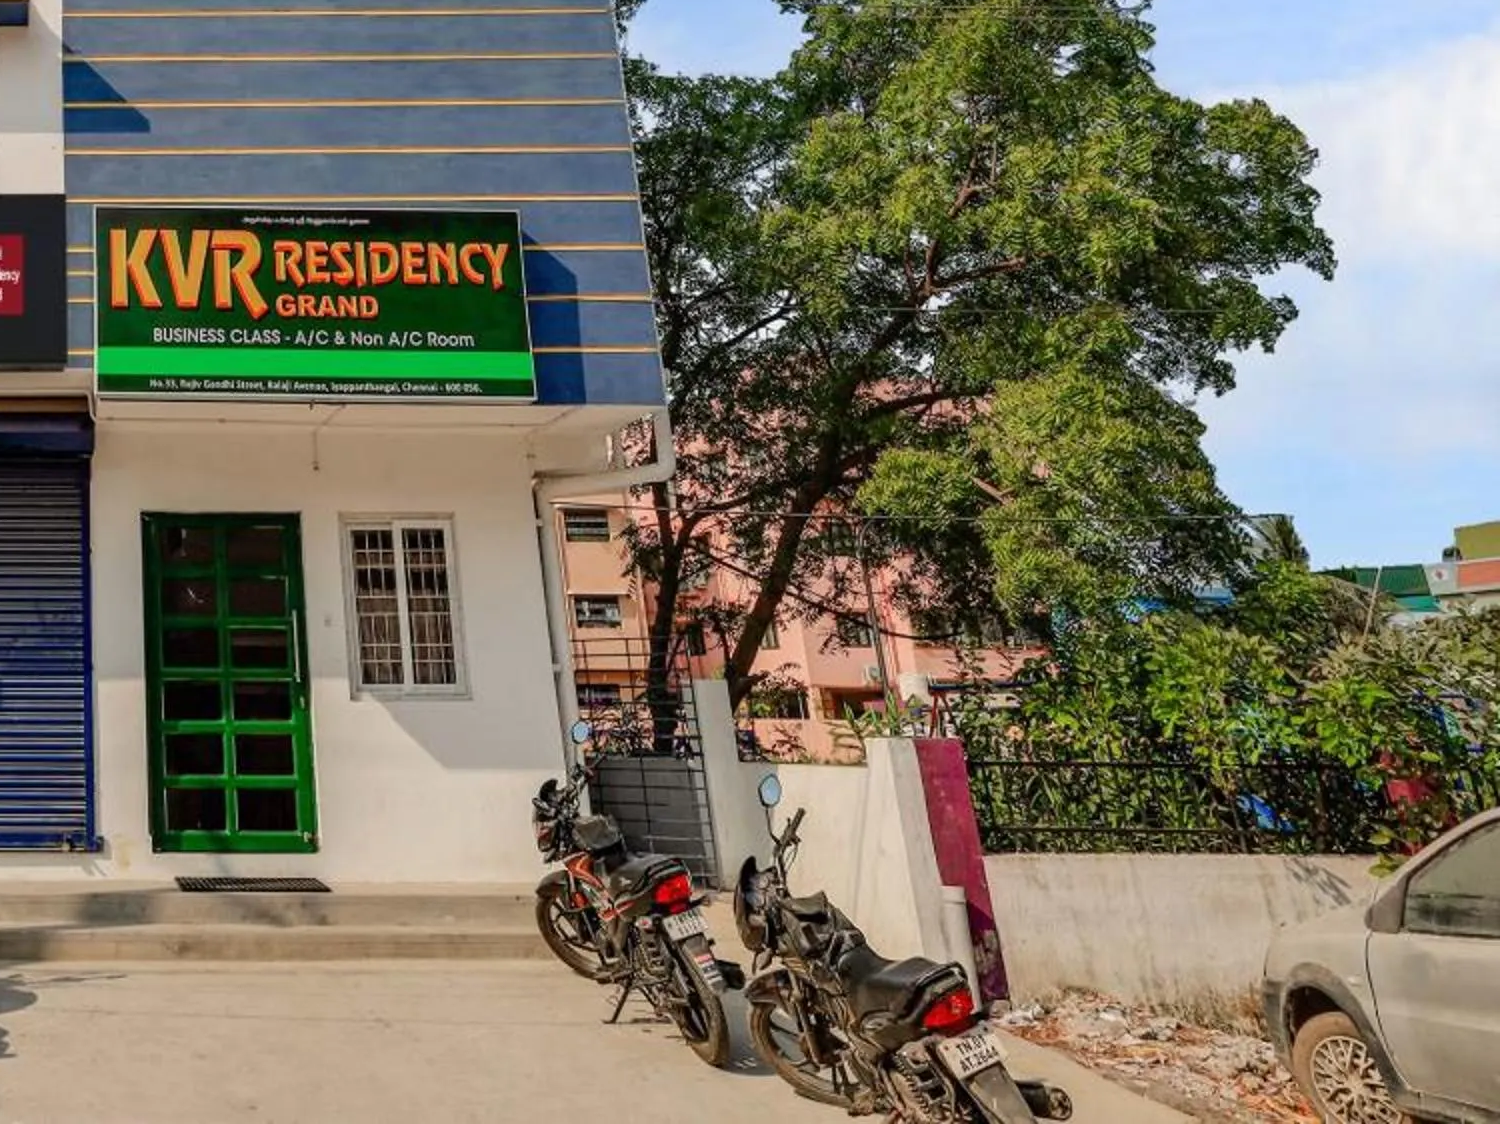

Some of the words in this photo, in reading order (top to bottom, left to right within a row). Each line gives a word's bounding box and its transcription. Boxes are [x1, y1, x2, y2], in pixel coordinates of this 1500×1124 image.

[109, 228, 269, 319] KVR
[273, 240, 510, 292] RESIDENCY
[275, 294, 380, 319] GRAND
[153, 327, 225, 343] BUSINESS
[230, 328, 281, 345] CLASS
[294, 329, 329, 346] A/C
[333, 330, 346, 345] &
[351, 331, 384, 346] Non
[388, 331, 423, 347] A/C
[427, 331, 475, 347] Room
